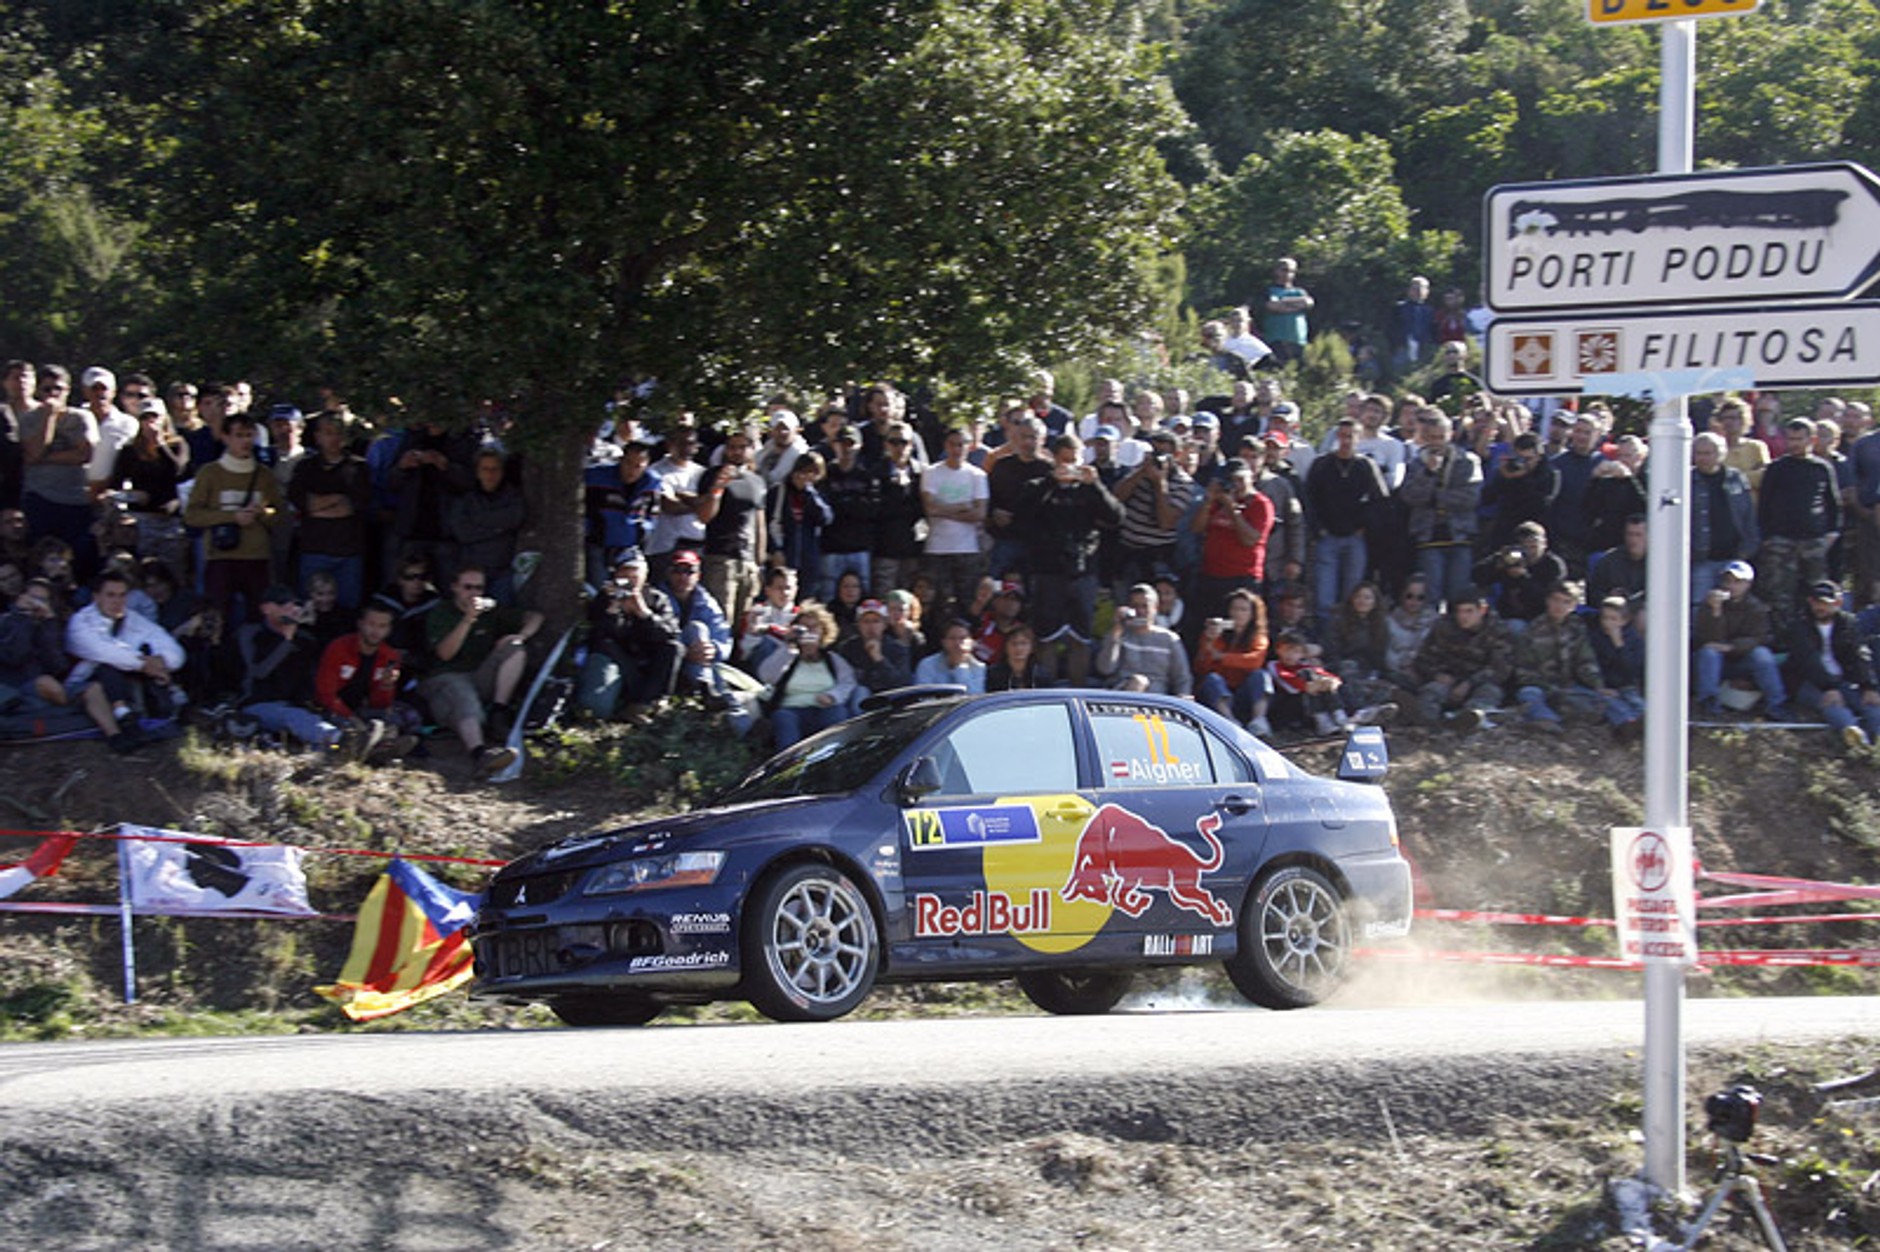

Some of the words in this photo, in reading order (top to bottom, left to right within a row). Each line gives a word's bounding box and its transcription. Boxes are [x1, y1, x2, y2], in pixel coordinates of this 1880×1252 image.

[1507, 250, 1636, 291] PORTI
[1660, 239, 1824, 284] PODDU
[1639, 326, 1858, 370] FILITOSA
[1132, 759, 1201, 783] Aigner
[907, 809, 944, 846] 72
[916, 891, 983, 935] Red
[987, 889, 1051, 934] Bull
[630, 951, 730, 969] BFGoodrich
